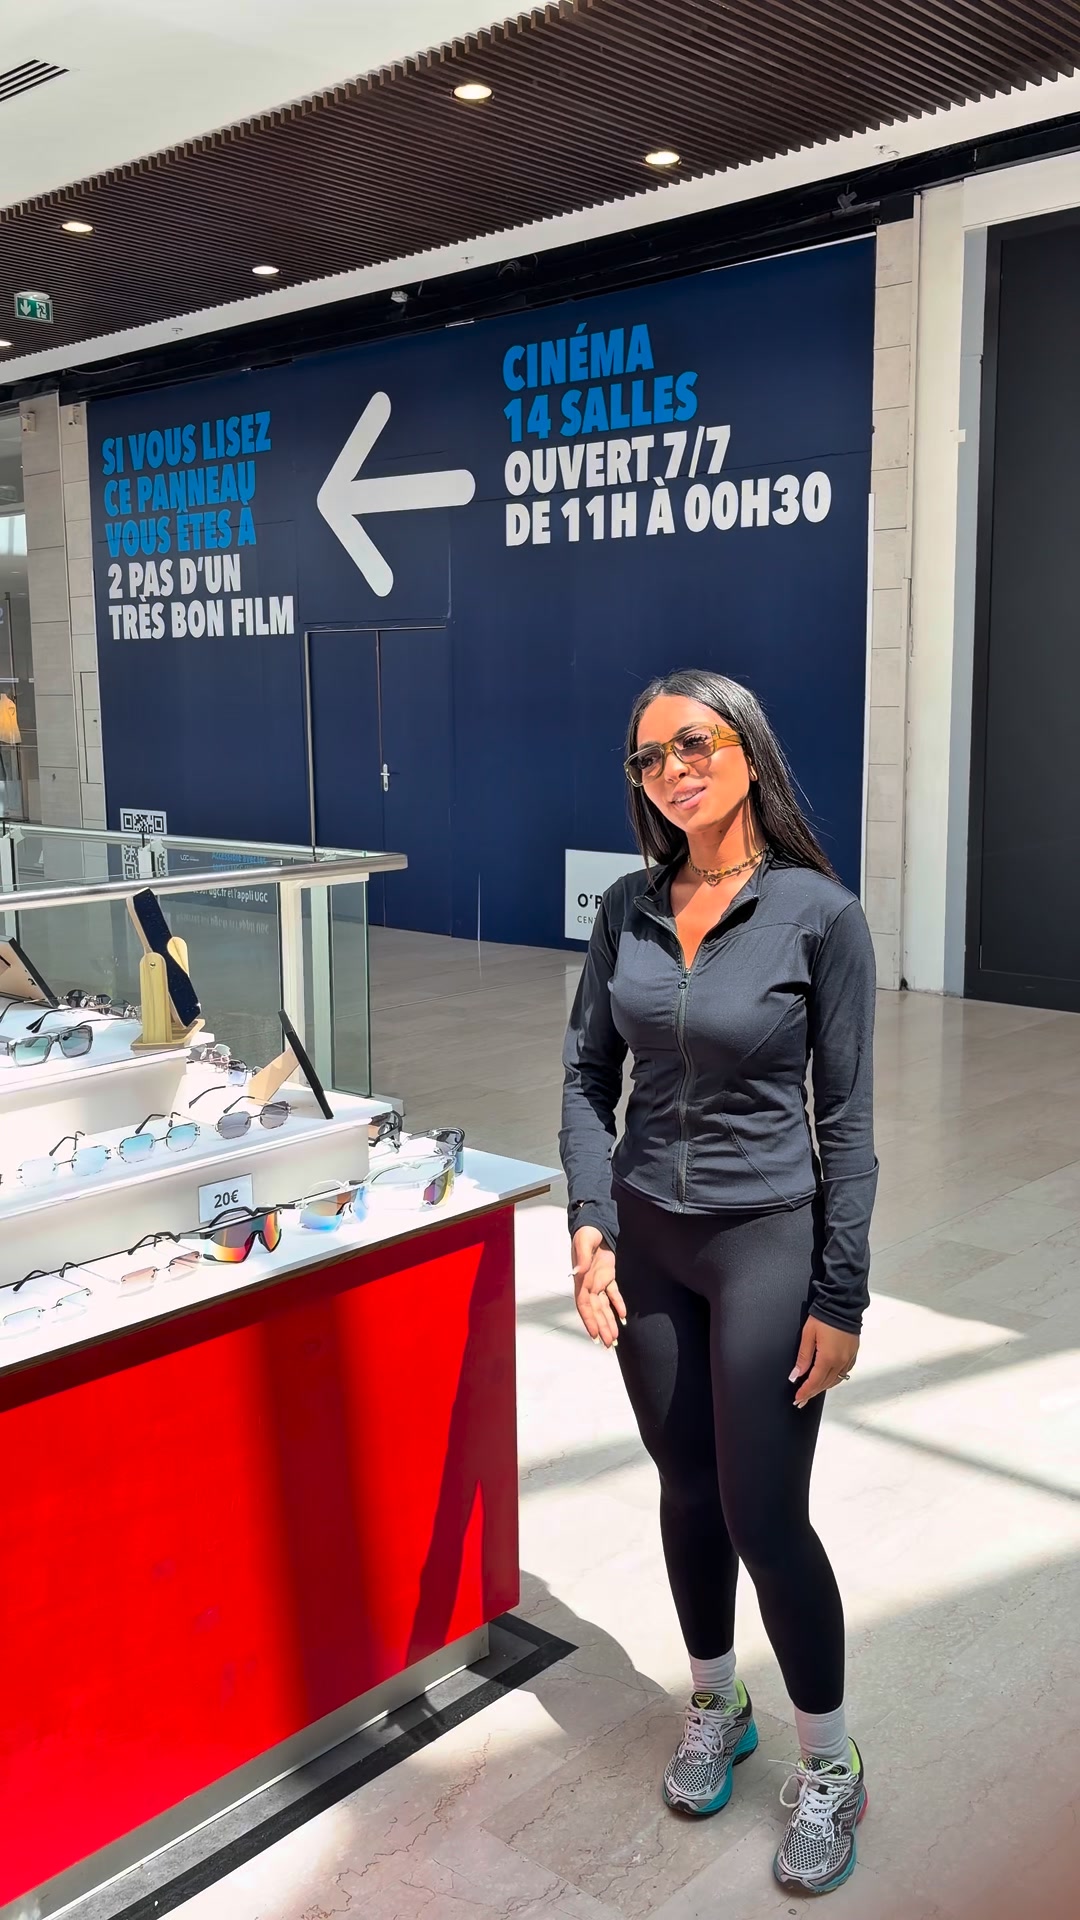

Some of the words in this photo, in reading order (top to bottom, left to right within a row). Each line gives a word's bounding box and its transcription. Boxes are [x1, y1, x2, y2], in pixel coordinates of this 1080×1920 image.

[503, 323, 654, 391] CINÉMA
[503, 394, 551, 442] 14
[561, 371, 698, 437] SALLES
[102, 437, 124, 475] SI
[128, 424, 196, 471] VOUS
[202, 411, 271, 460] LISEZ
[504, 435, 654, 496] OUVERT
[663, 424, 731, 478] 7/7
[104, 479, 132, 517] CE
[137, 460, 256, 513] PANNEAU
[506, 501, 551, 546] DE
[561, 491, 637, 542] 11H
[646, 476, 675, 535] À
[684, 471, 832, 533] 00H30
[105, 516, 171, 557] VOUS
[177, 503, 232, 552] ÊTES
[238, 498, 256, 546] À
[107, 563, 123, 599] 2
[128, 559, 174, 598] PAS
[180, 553, 241, 595] D'UN
[108, 594, 165, 640] TRÈS
[171, 600, 224, 638] BON
[231, 595, 294, 636] FILM
[254, 892, 268, 903] UGC
[577, 915, 597, 924] CEN
[214, 1189, 239, 1208] 20€
